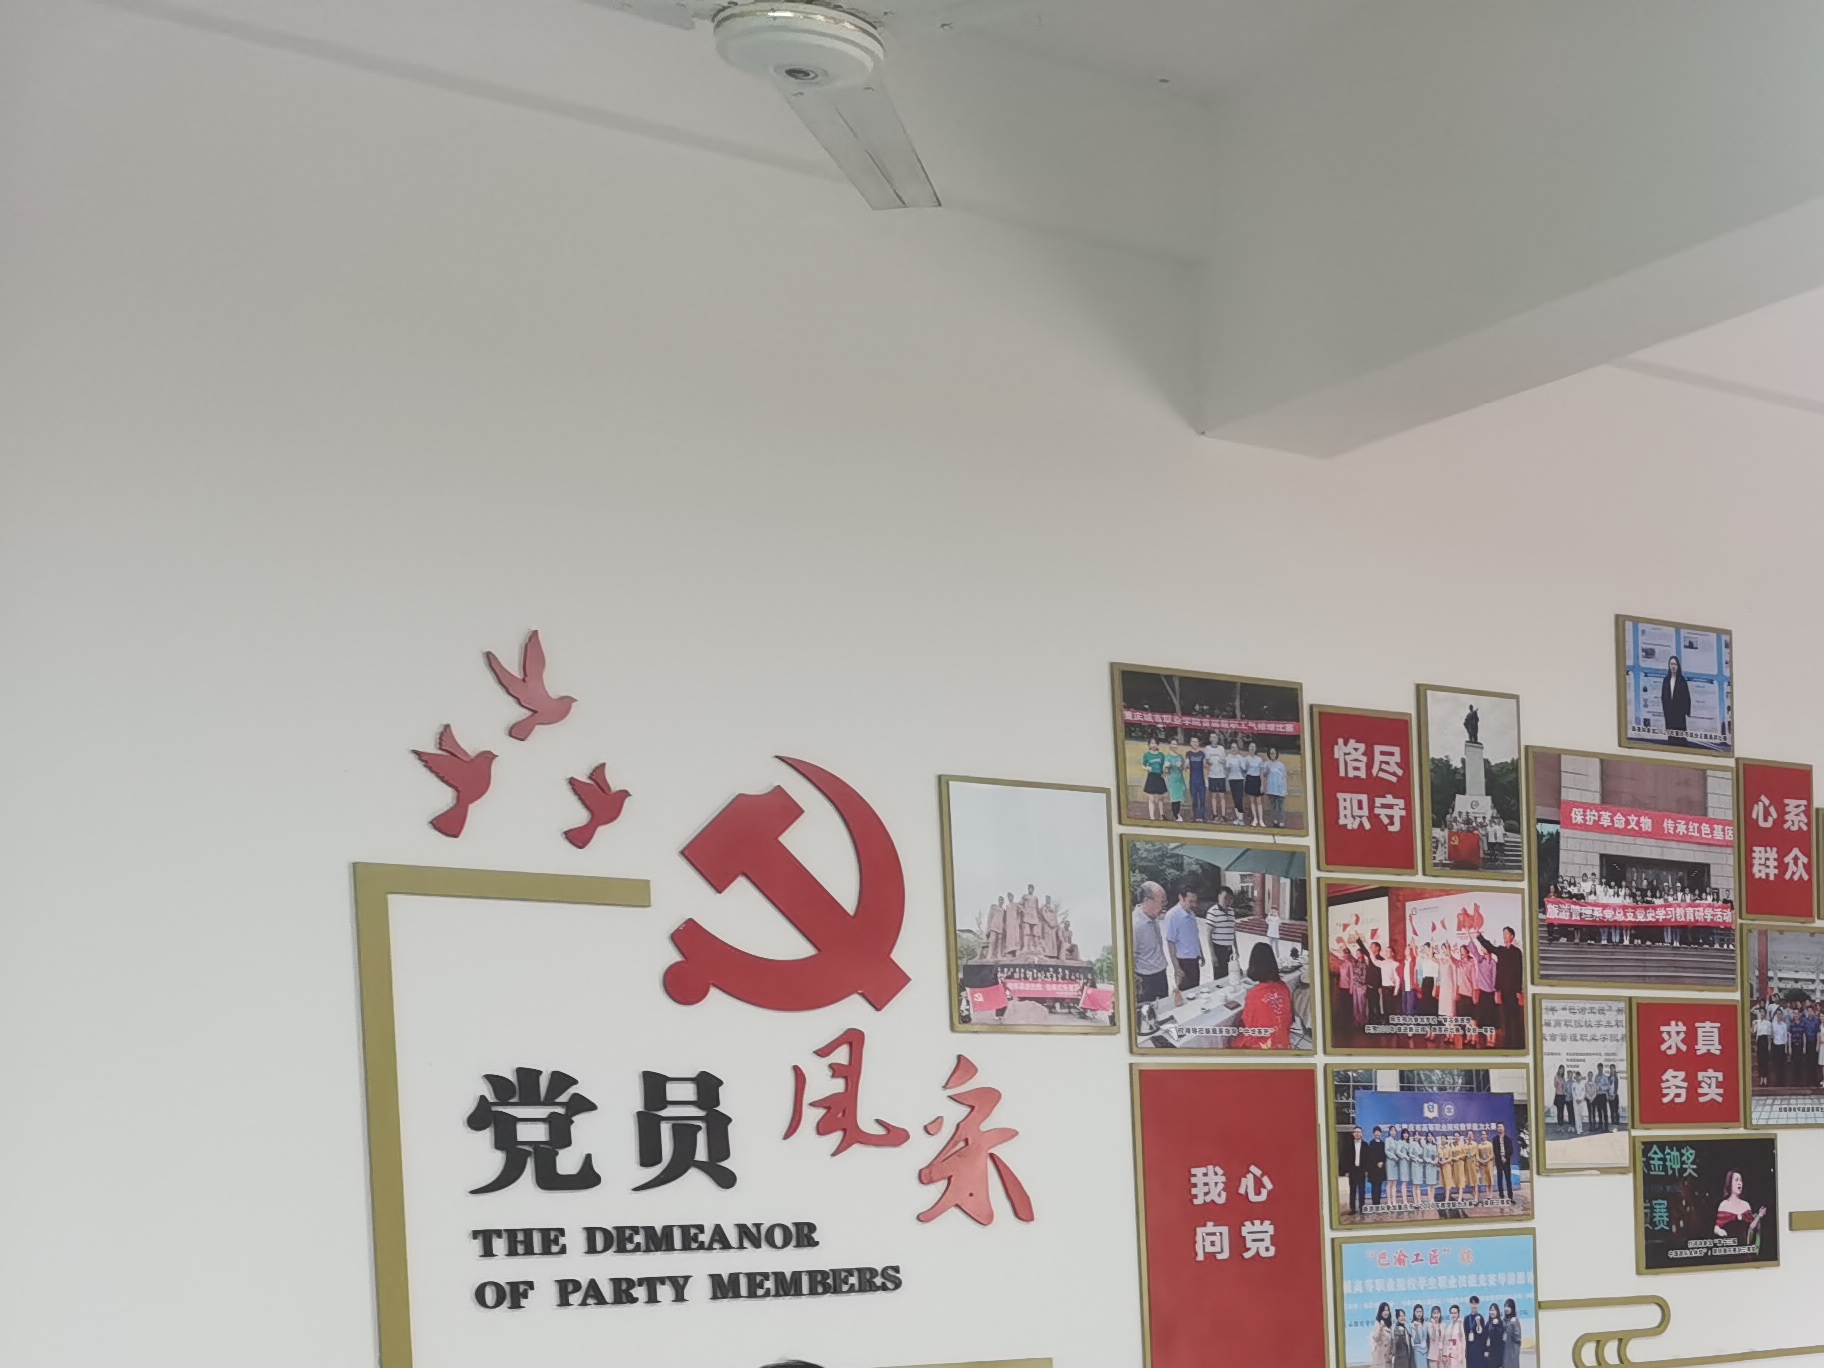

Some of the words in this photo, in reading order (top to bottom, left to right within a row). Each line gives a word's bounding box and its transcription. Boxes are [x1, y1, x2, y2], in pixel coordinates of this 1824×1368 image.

[1333, 736, 1405, 784] 恪尽
[1337, 791, 1407, 833] 职守
[1571, 807, 1652, 832] 保护革命文物
[1751, 794, 1809, 833] 心系
[1751, 845, 1810, 883] 群众
[1660, 1019, 1723, 1057] 求真
[1660, 1066, 1725, 1106] 务实
[466, 1066, 738, 1195] 党员
[782, 1027, 1036, 1226] 风采
[1190, 1164, 1274, 1206] 我心
[471, 1226, 568, 1260] THE
[582, 1220, 820, 1257] DEMEANOR
[1195, 1218, 1276, 1262] 向党
[474, 1279, 535, 1312] OF
[556, 1273, 691, 1307] PARTY
[710, 1265, 904, 1302] MEMBERS
